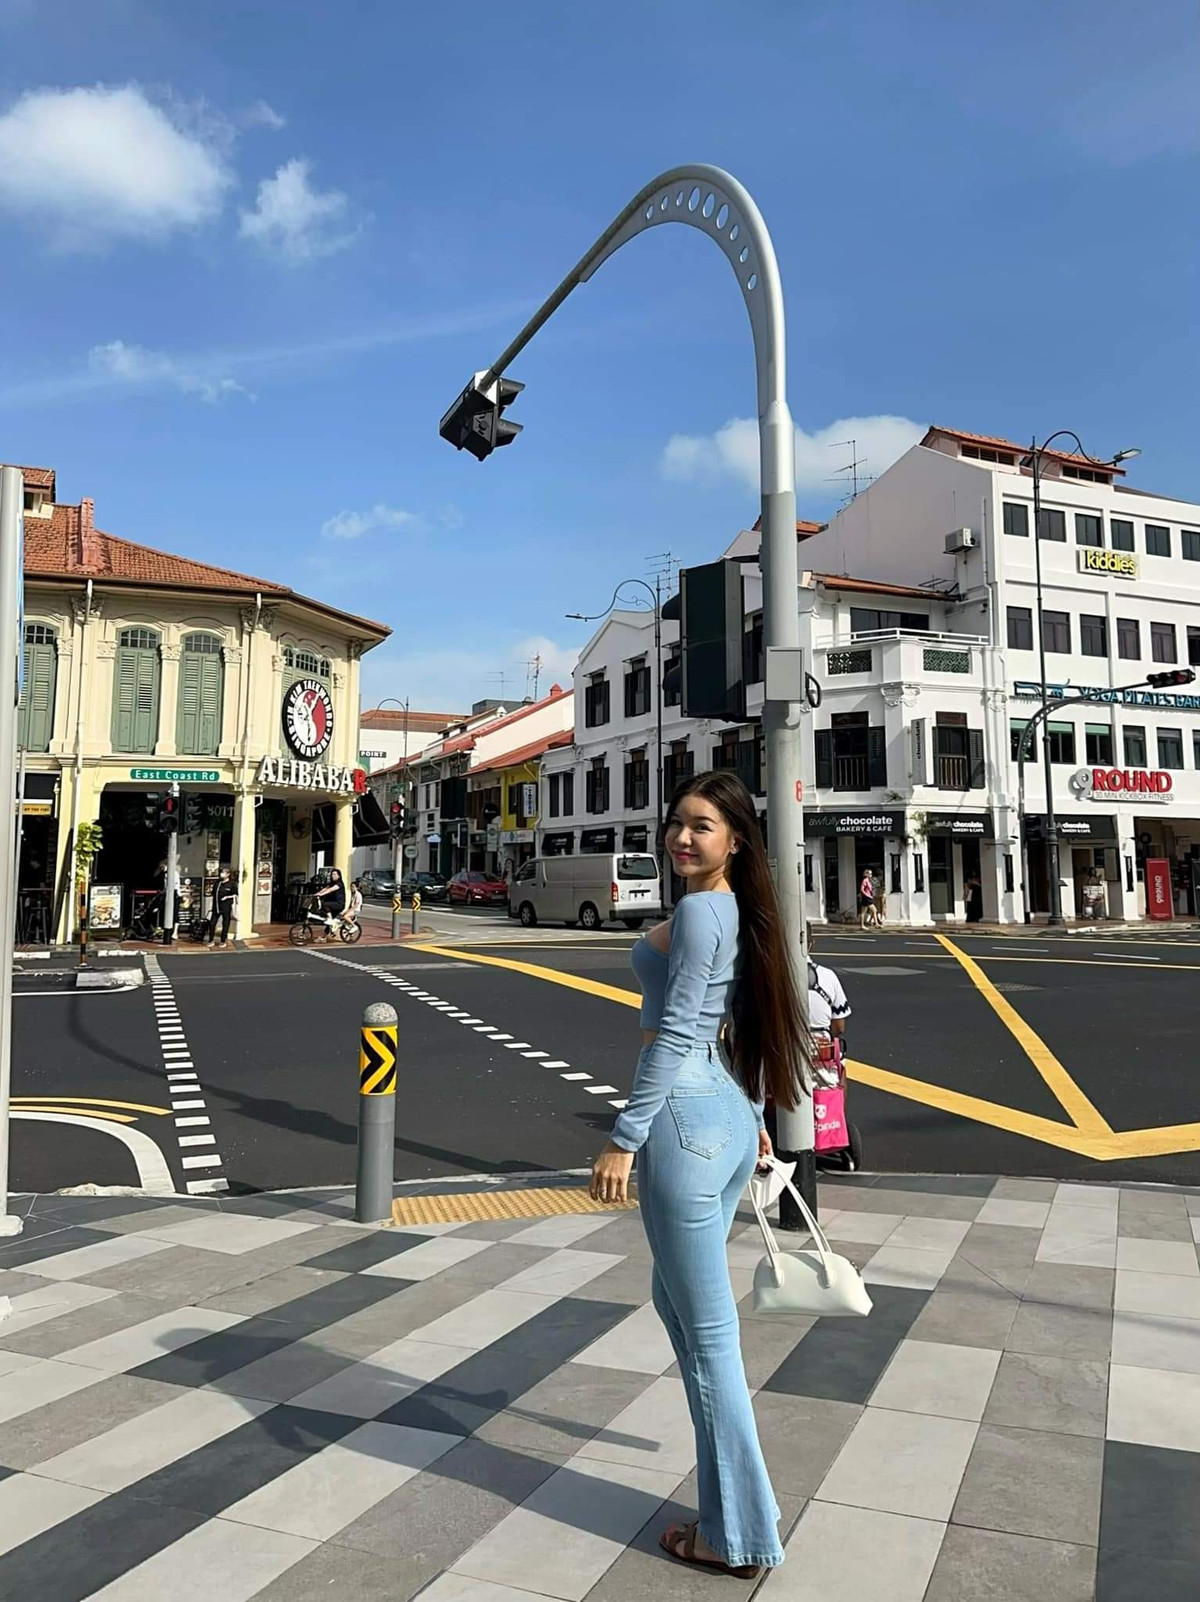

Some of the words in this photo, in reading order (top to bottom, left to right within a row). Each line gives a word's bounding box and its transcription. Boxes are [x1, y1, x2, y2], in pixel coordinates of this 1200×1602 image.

[288, 726, 331, 757] SINGAPORE
[135, 769, 160, 779] East
[165, 770, 197, 780] Coast
[202, 771, 215, 781] Rd
[258, 755, 367, 794] ALIBABAR
[1148, 793, 1175, 801] FITNESS
[840, 816, 893, 826] chocolate
[836, 825, 865, 833] BAKERY
